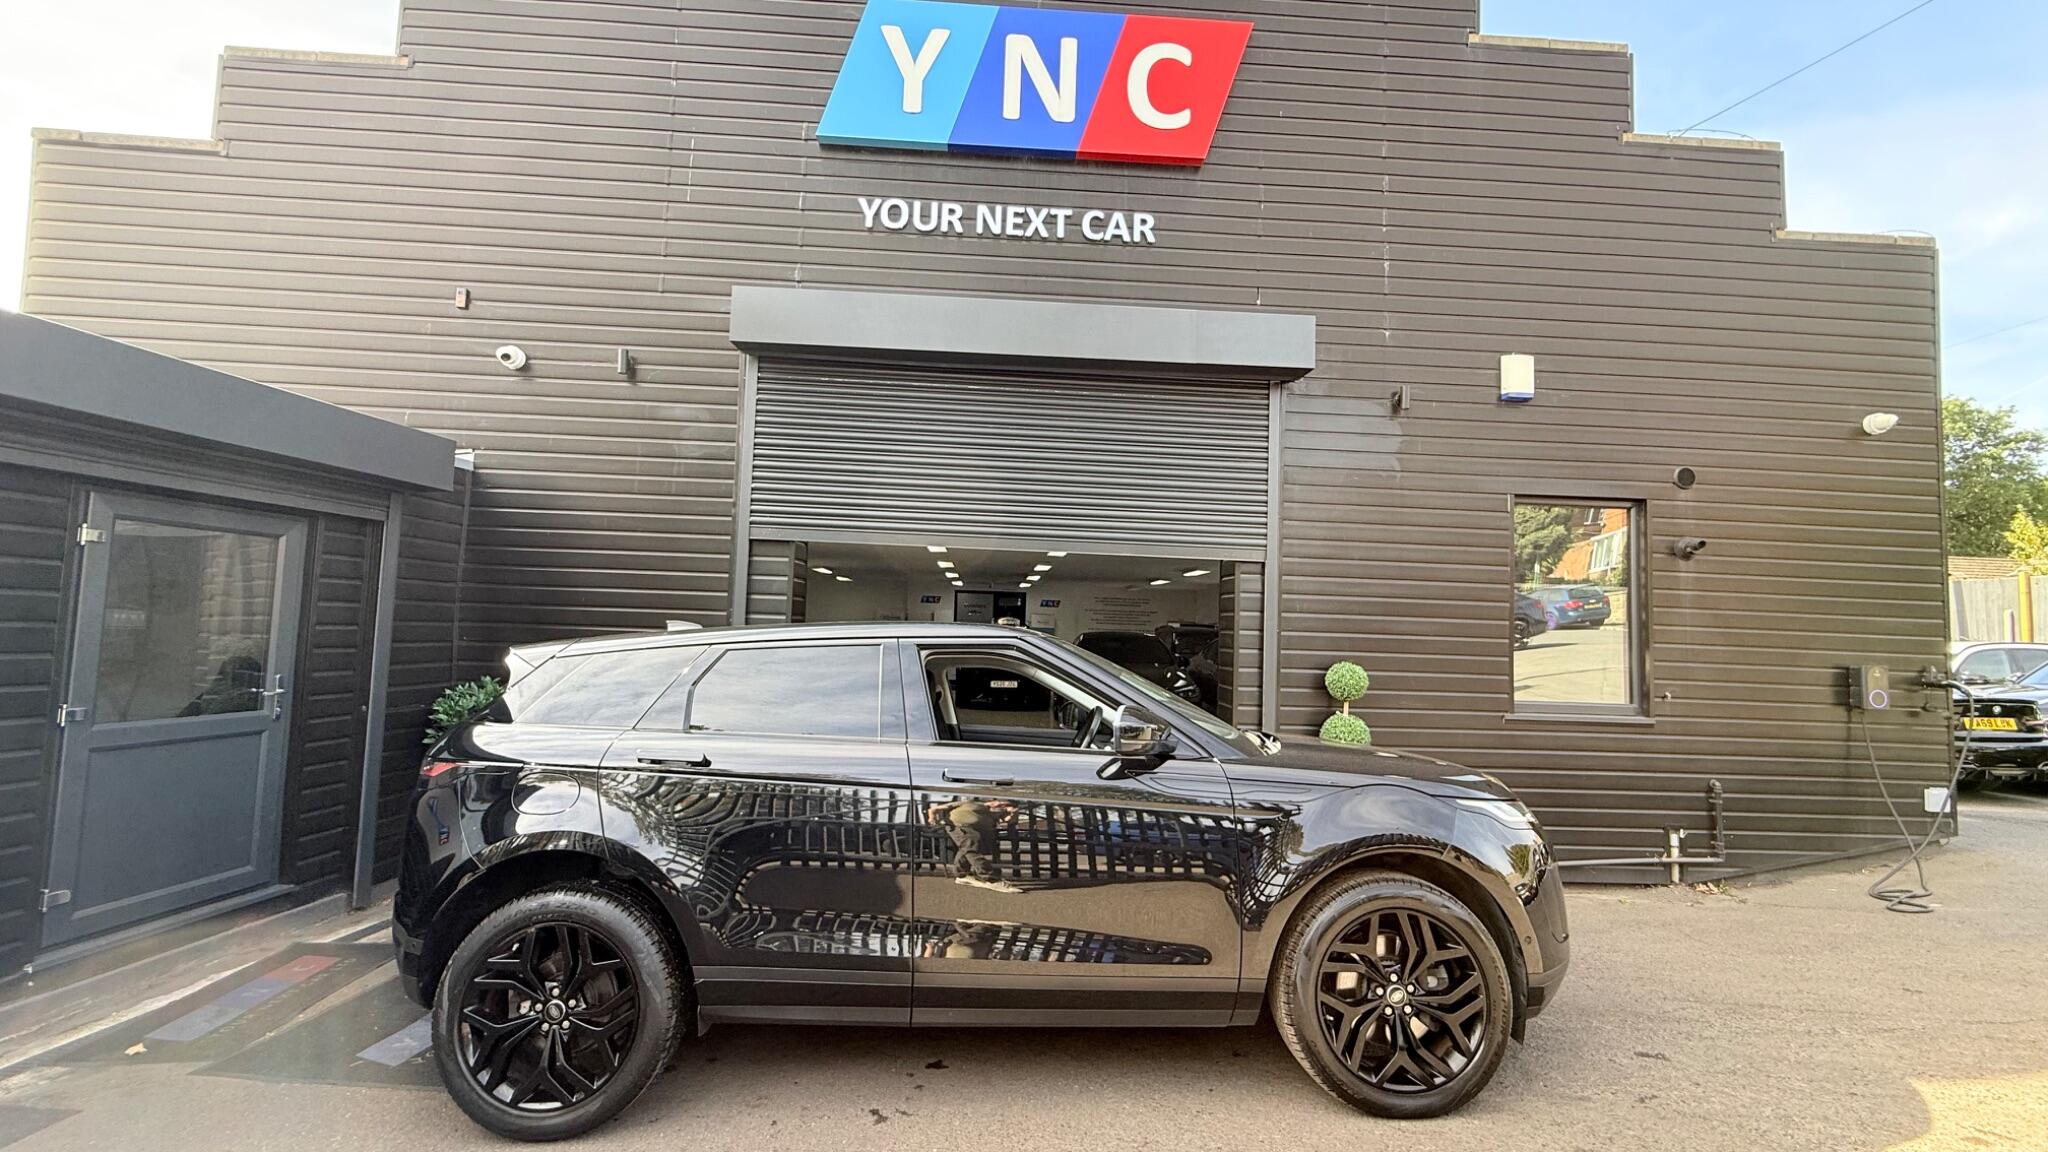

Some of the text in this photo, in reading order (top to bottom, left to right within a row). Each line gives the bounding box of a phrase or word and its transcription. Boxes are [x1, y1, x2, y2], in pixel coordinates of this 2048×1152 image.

[880, 24, 1193, 130] YNC
[857, 197, 1156, 244] YOUR NEXT CAR
[1967, 718, 1994, 728] A69
